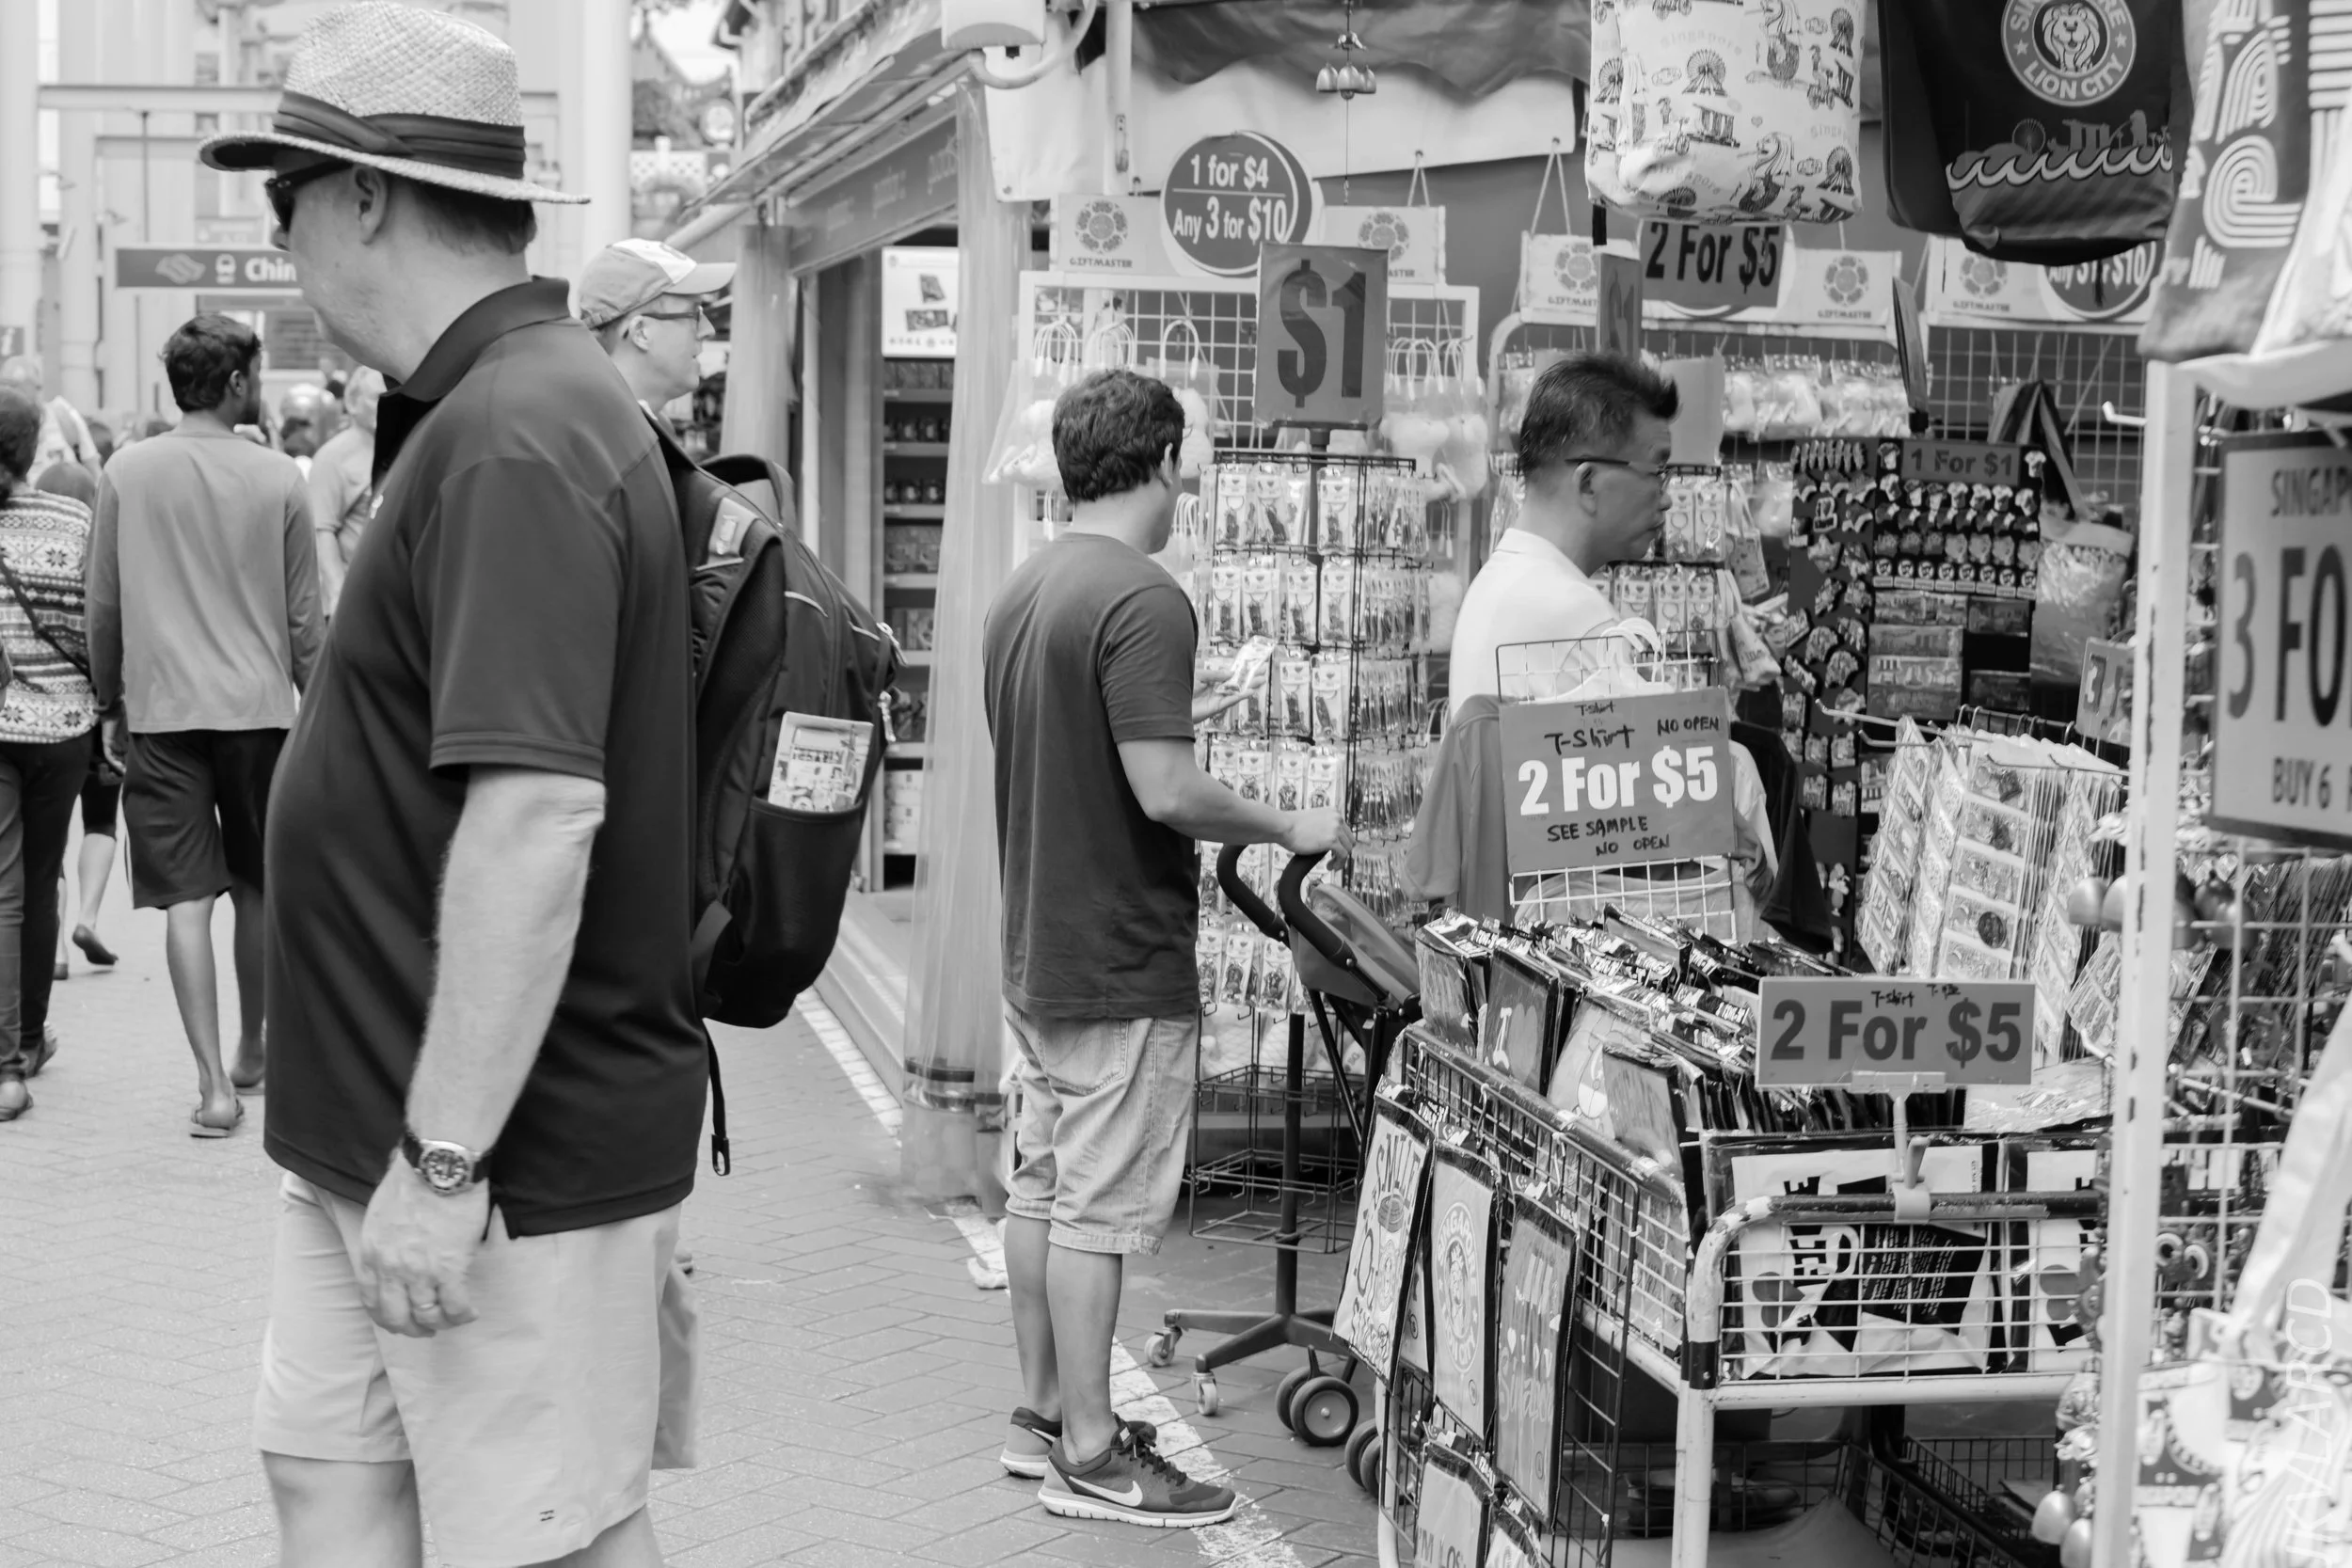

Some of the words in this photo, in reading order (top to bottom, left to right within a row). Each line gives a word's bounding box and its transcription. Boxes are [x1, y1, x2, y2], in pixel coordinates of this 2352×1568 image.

[2023, 59, 2077, 100] LION
[2080, 53, 2124, 97] CITY
[1190, 154, 1200, 185] 1
[1208, 154, 1239, 187] for
[1243, 155, 1269, 192] $4
[1173, 208, 1202, 245] Any
[1205, 196, 1220, 239] 3
[1223, 211, 1245, 240] for
[1248, 196, 1287, 245] $10
[1645, 221, 1669, 279] 2
[1677, 224, 1732, 283] For
[1739, 225, 1780, 294] $5
[1548, 295, 1598, 308] GIFTMAST
[1278, 260, 1366, 407] $1
[1911, 448, 1923, 471] 1
[1934, 449, 1977, 474] For
[1984, 451, 2012, 478] $1
[2270, 465, 2352, 518] SINGAP
[2228, 551, 2257, 720] 3
[2274, 544, 2352, 727] FO
[1657, 718, 1679, 736] NO
[1683, 716, 1719, 732] OPEN
[1518, 759, 1549, 816] 2
[1562, 756, 1641, 812] For
[1651, 745, 1718, 809] $5
[2273, 755, 2315, 806] BUY
[2317, 763, 2332, 810] 6
[1547, 823, 1581, 842] SEE
[1585, 816, 1648, 837] SAMPLE
[1596, 841, 1619, 856] NO
[1633, 834, 1670, 851] OPEN
[1770, 999, 1806, 1061] 2
[1828, 1000, 1929, 1061] For
[1946, 996, 2022, 1069] $5
